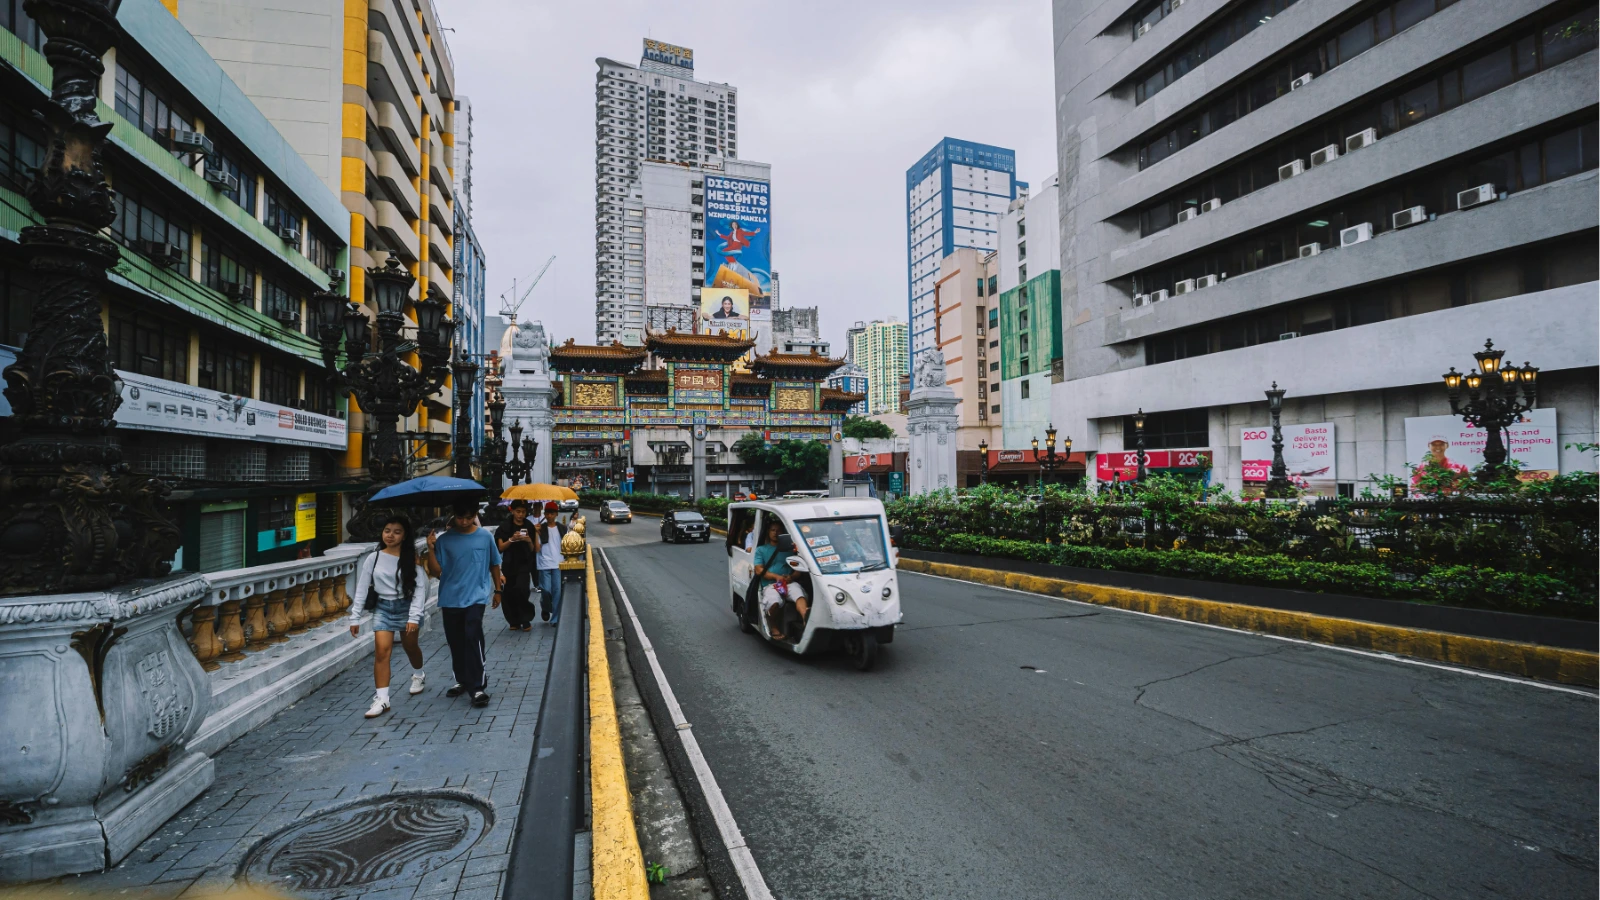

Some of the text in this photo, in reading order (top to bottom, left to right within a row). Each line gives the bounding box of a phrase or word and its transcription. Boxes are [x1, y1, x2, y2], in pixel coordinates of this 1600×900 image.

[643, 47, 693, 69] Anchor Land
[707, 178, 768, 194] DISCOVER
[707, 189, 768, 206] HEIGHTS
[708, 202, 767, 215] POSSIBILITY
[708, 211, 768, 223] WINFORD MANILA
[680, 375, 717, 386] 中國城
[1243, 431, 1267, 440] 2GO
[1477, 430, 1518, 438] Doestic
[1311, 449, 1328, 457] yan!
[1178, 454, 1200, 466] 2G
[1244, 469, 1264, 478] 2GO
[1521, 471, 1549, 480] 2GO
